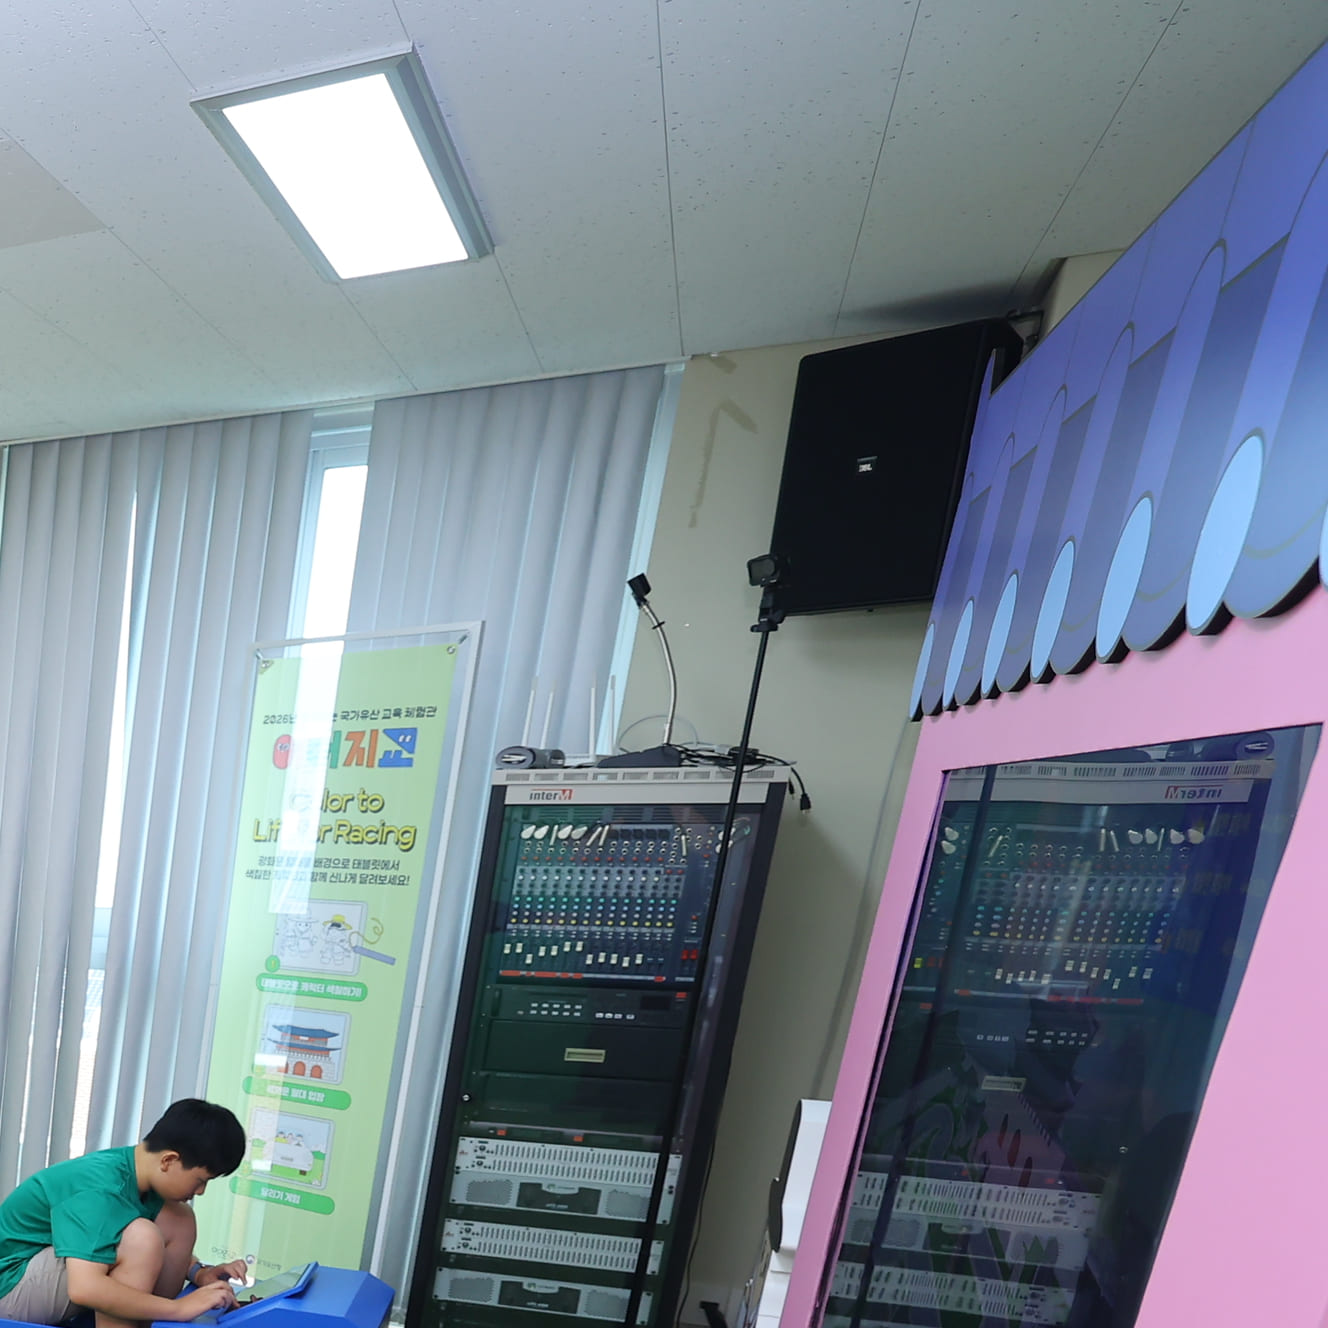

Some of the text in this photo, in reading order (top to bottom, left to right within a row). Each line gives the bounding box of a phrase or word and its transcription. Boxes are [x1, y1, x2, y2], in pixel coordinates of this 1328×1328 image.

[341, 709, 380, 721] 국가유산
[382, 708, 402, 720] 교육
[356, 787, 385, 813] to
[334, 819, 417, 852] Racing
[313, 857, 350, 870] 배경으로
[352, 858, 401, 871] 태블릿에서
[329, 872, 357, 884] 신나게
[359, 873, 411, 886] 달려보세요!
